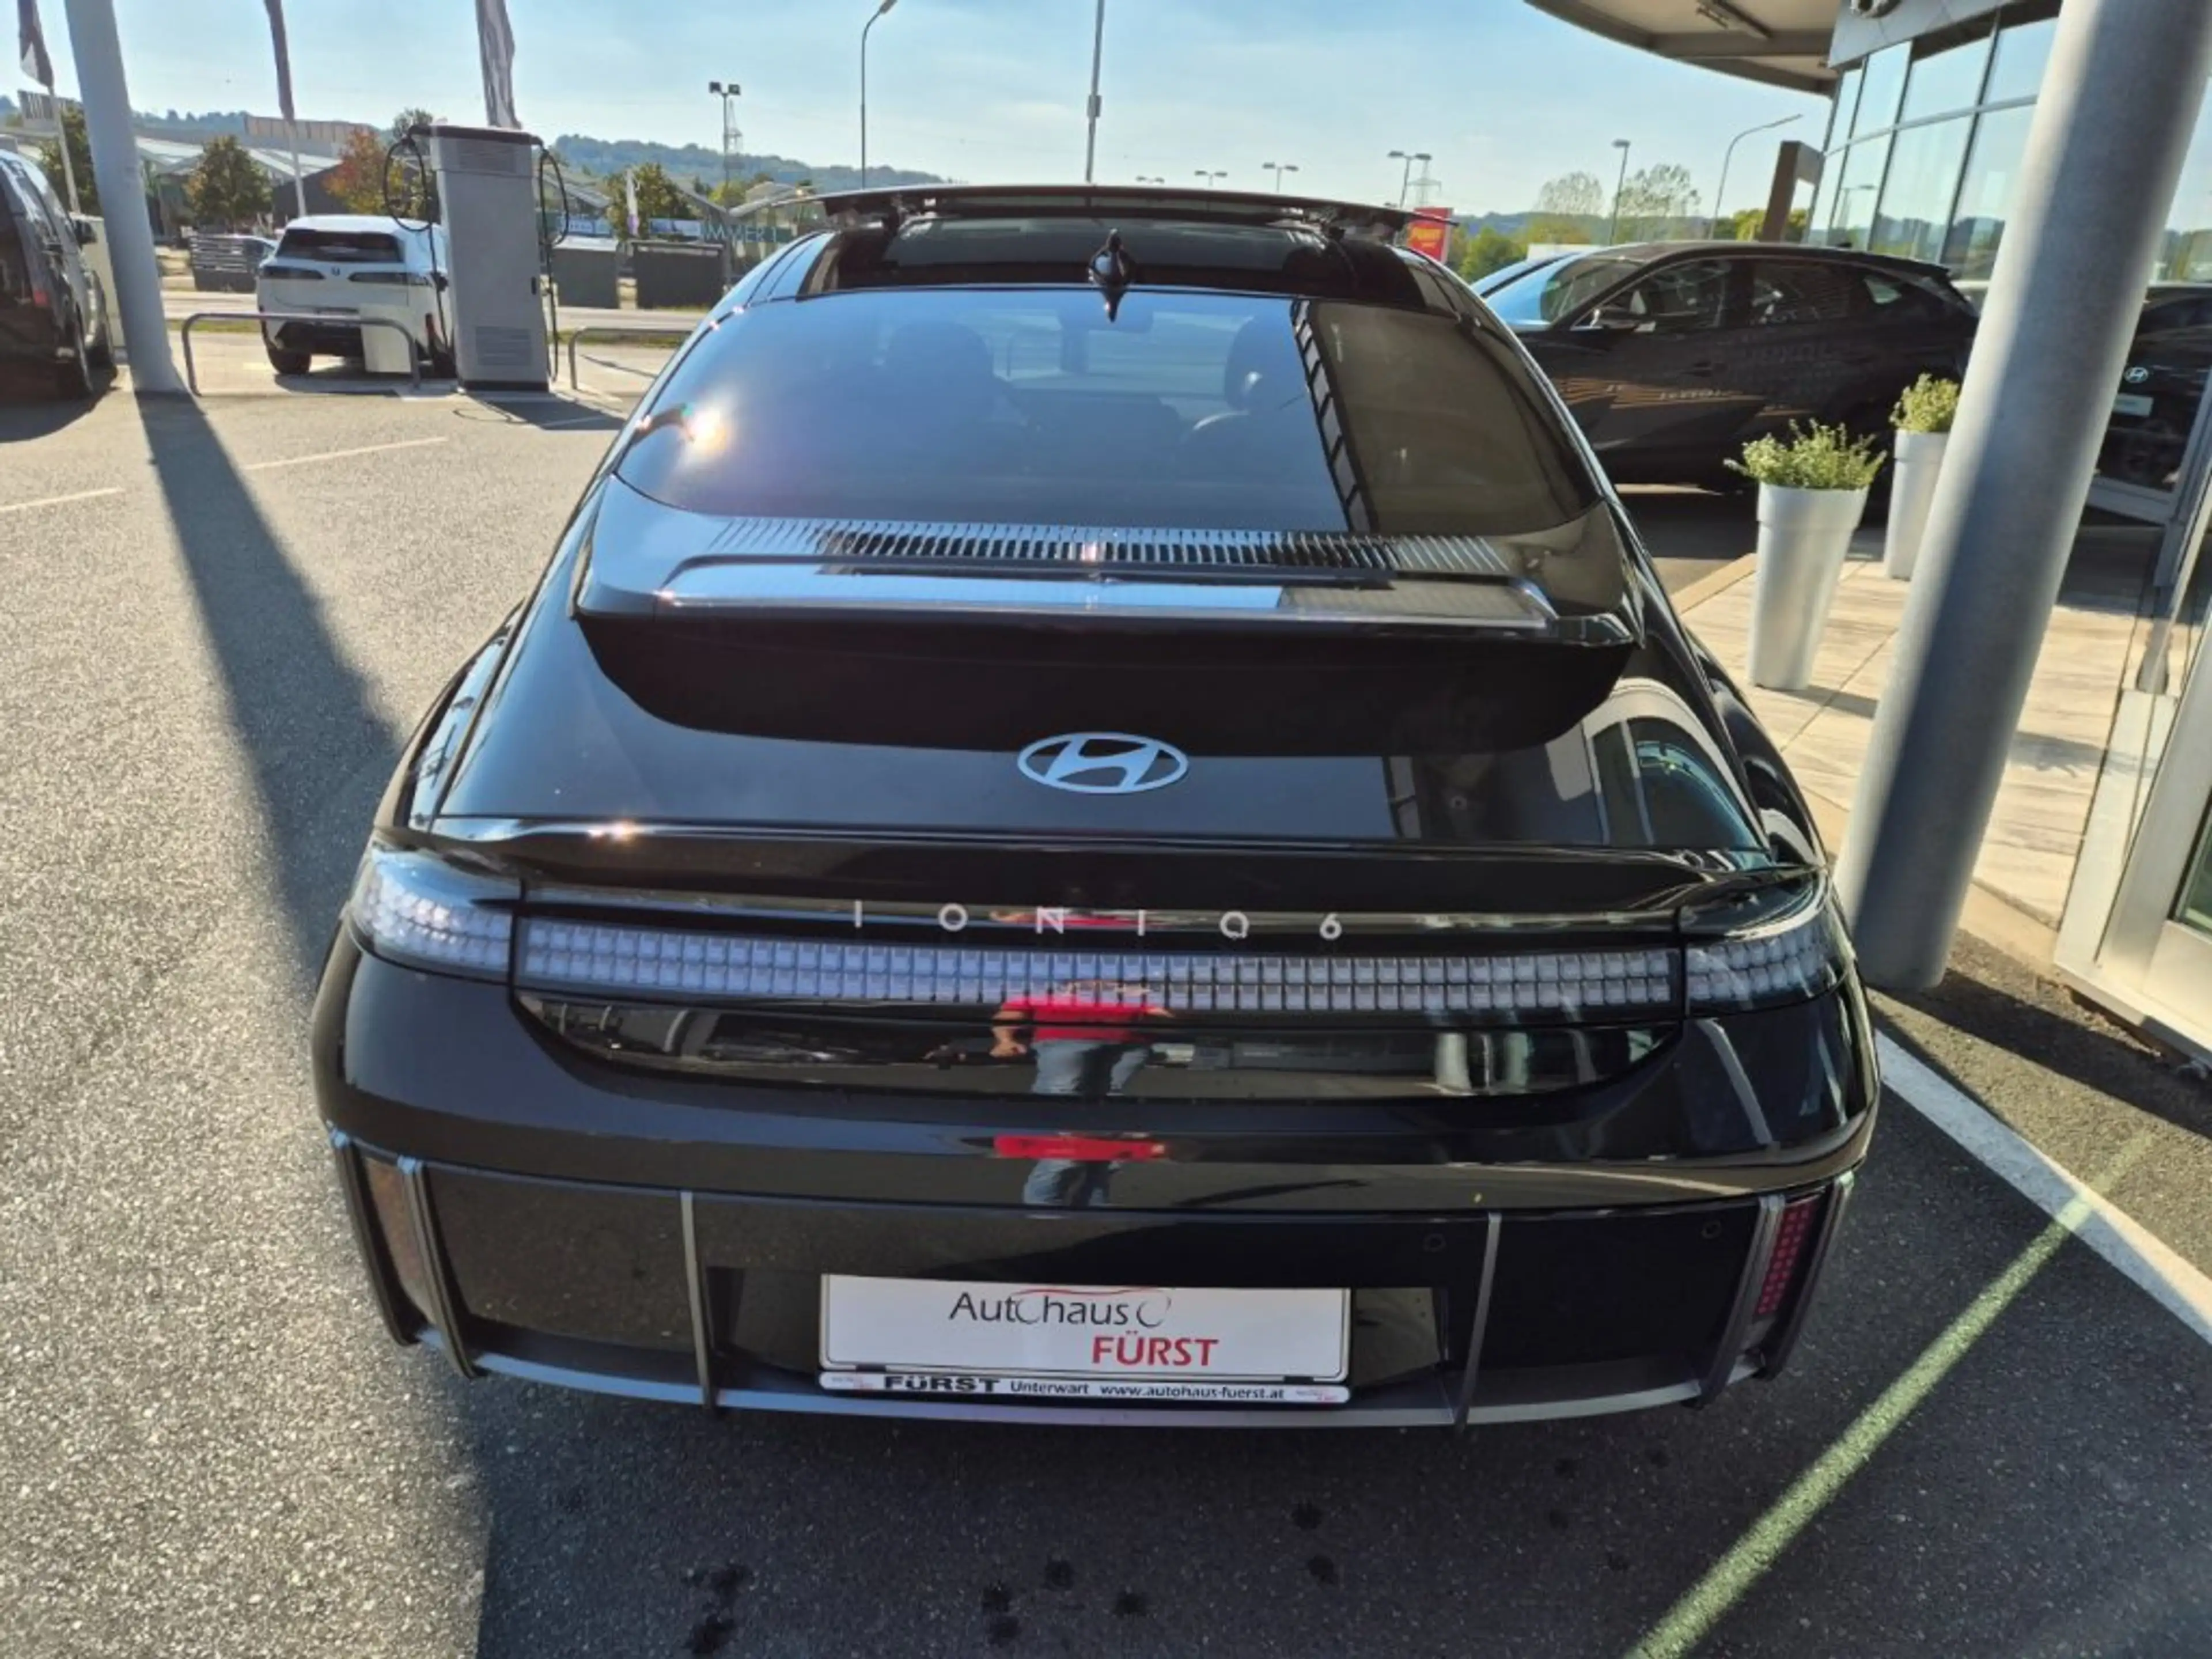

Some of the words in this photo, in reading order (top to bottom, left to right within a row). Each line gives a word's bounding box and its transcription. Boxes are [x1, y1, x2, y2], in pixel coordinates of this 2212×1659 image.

[854, 900, 1249, 939] IONIQ
[1319, 913, 1342, 940] 6
[1092, 1330, 1219, 1366] FÜRST
[1010, 1380, 1089, 1395] Unterwart
[1100, 1383, 1285, 1400] www.autohaus-fuerst.at
